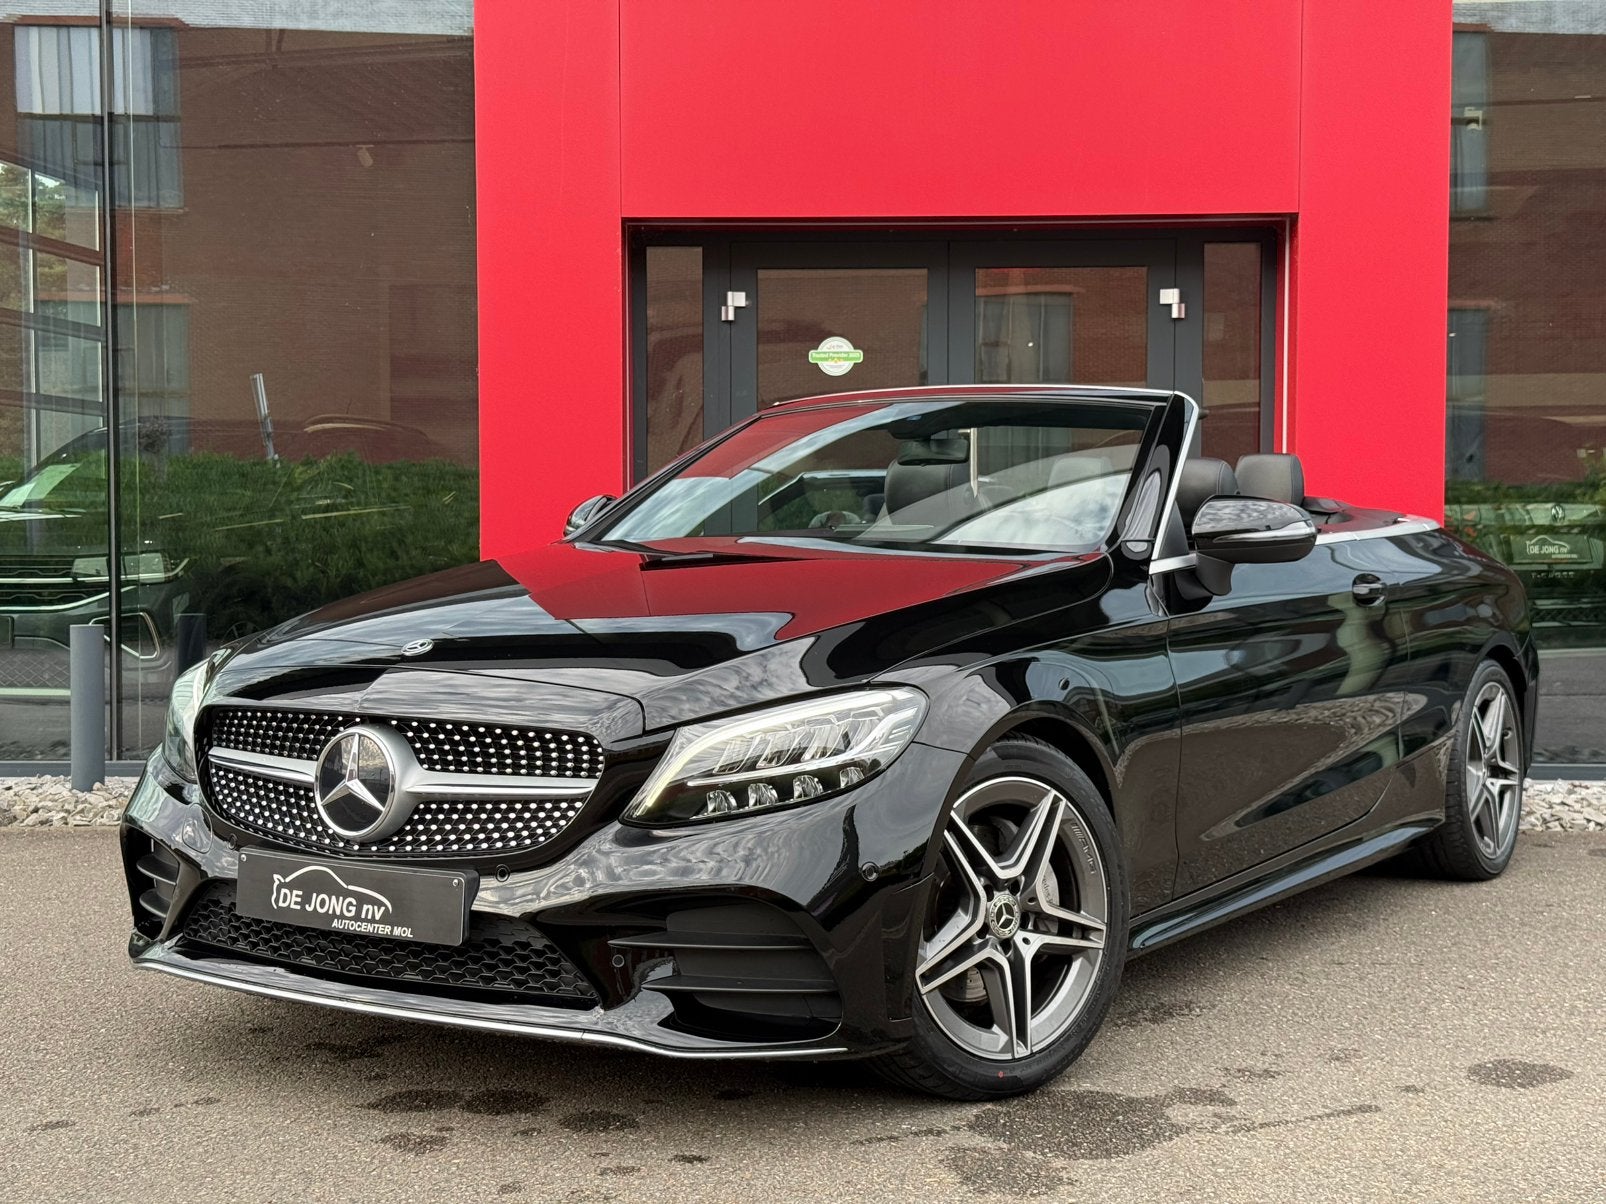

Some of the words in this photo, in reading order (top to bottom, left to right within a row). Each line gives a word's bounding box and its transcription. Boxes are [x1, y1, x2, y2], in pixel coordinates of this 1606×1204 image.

[1529, 545, 1539, 554] DE
[1540, 545, 1559, 554] JONG
[278, 888, 303, 910] DE
[305, 893, 357, 917] JONG
[331, 918, 391, 936] AUTOCENTER
[393, 925, 414, 938] MOL
